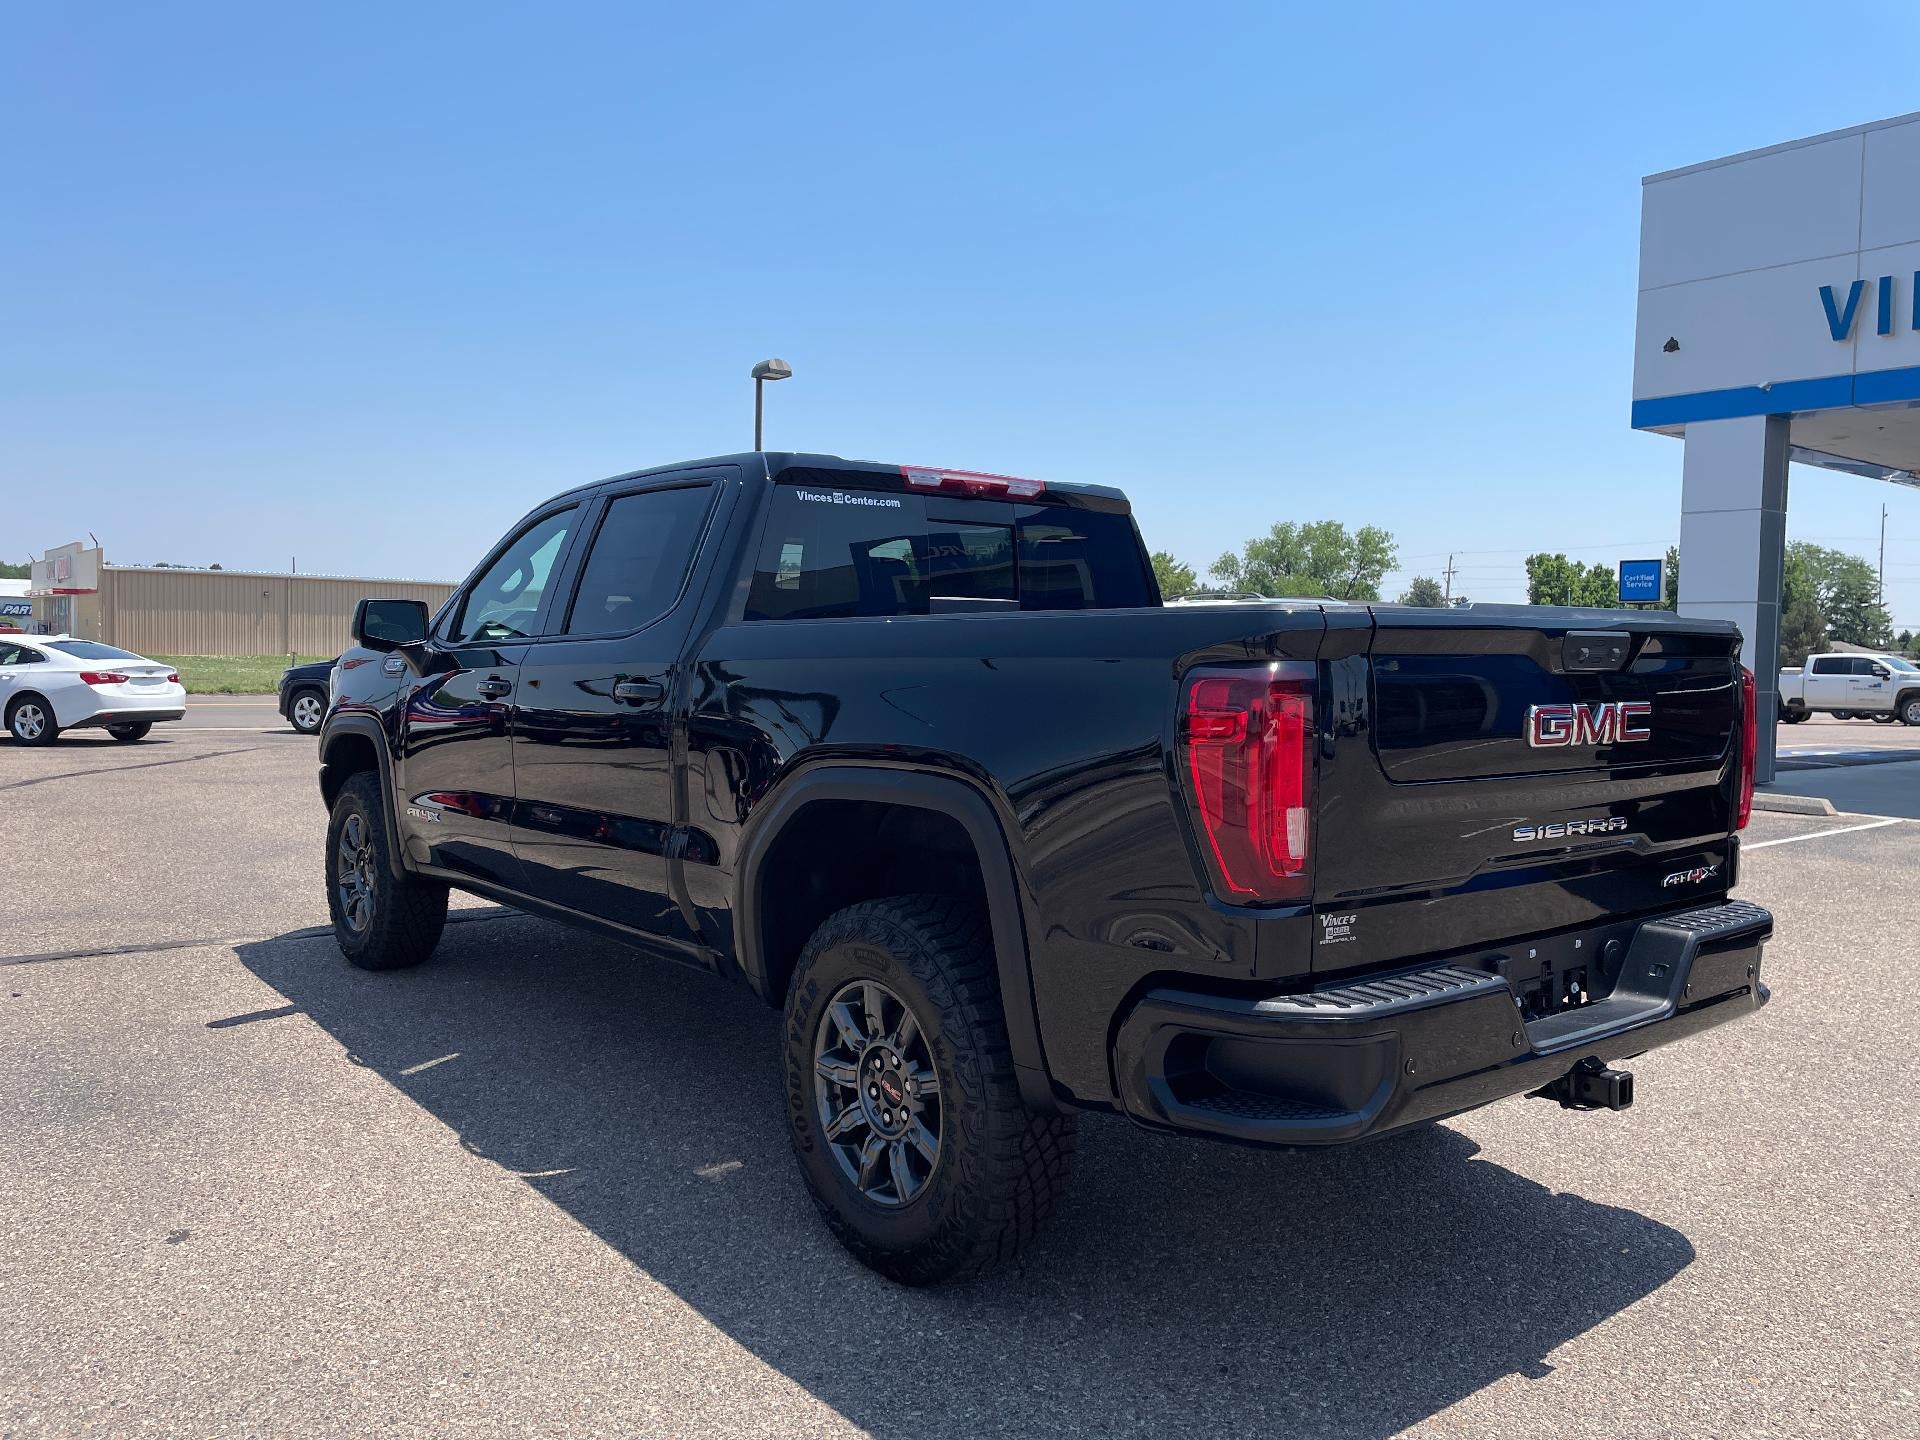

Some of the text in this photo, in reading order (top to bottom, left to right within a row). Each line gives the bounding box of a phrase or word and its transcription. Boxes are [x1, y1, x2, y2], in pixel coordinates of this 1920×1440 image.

[1818, 271, 1920, 341] VI
[1624, 574, 1655, 582] Certified
[1526, 701, 1652, 747] GMC
[1512, 816, 1628, 842] SIERRA
[1662, 864, 1718, 888] AT4X
